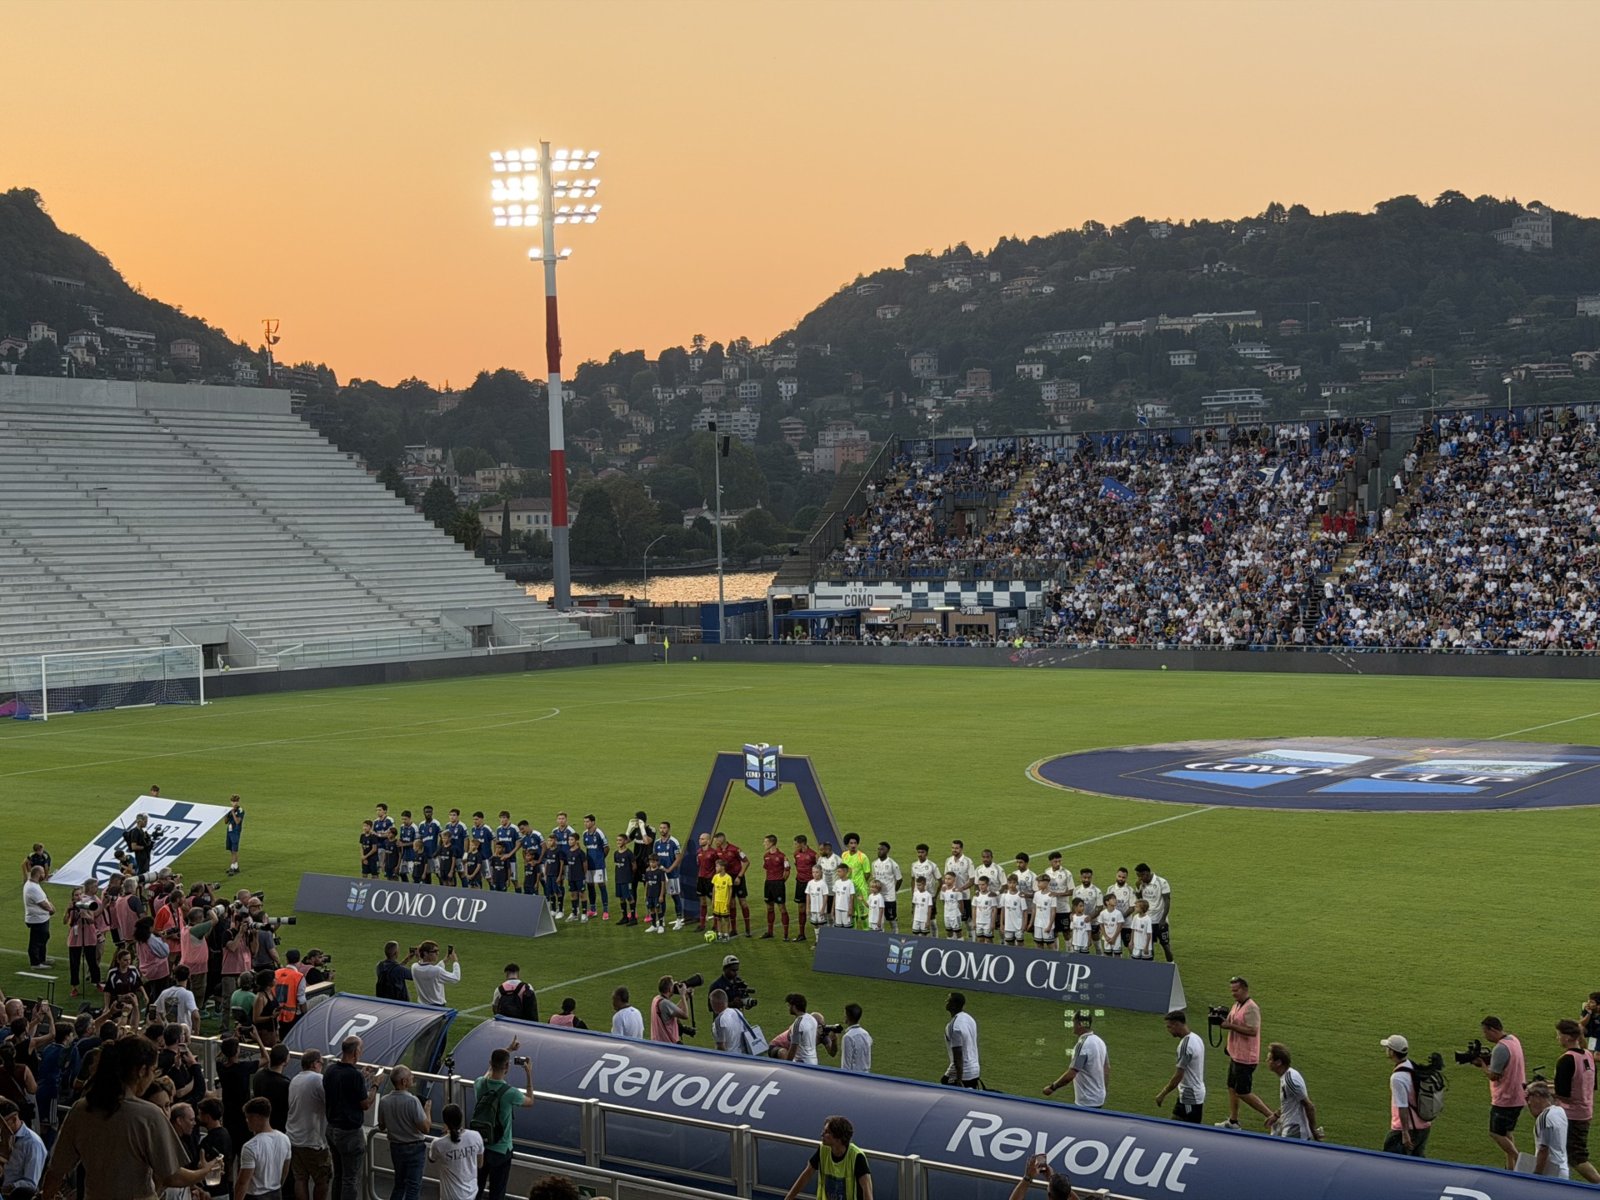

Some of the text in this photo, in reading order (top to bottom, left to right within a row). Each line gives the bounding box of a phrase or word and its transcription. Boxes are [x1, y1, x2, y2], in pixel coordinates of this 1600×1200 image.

[844, 594, 874, 607] COMO
[966, 606, 984, 615] STORE
[1184, 762, 1517, 785] COMO CUP
[371, 889, 487, 923] COMO CUP
[921, 947, 1091, 993] COMO CUP
[578, 1053, 781, 1119] Revolut
[446, 1145, 476, 1161] STAFF
[946, 1111, 1199, 1193] Revolut
